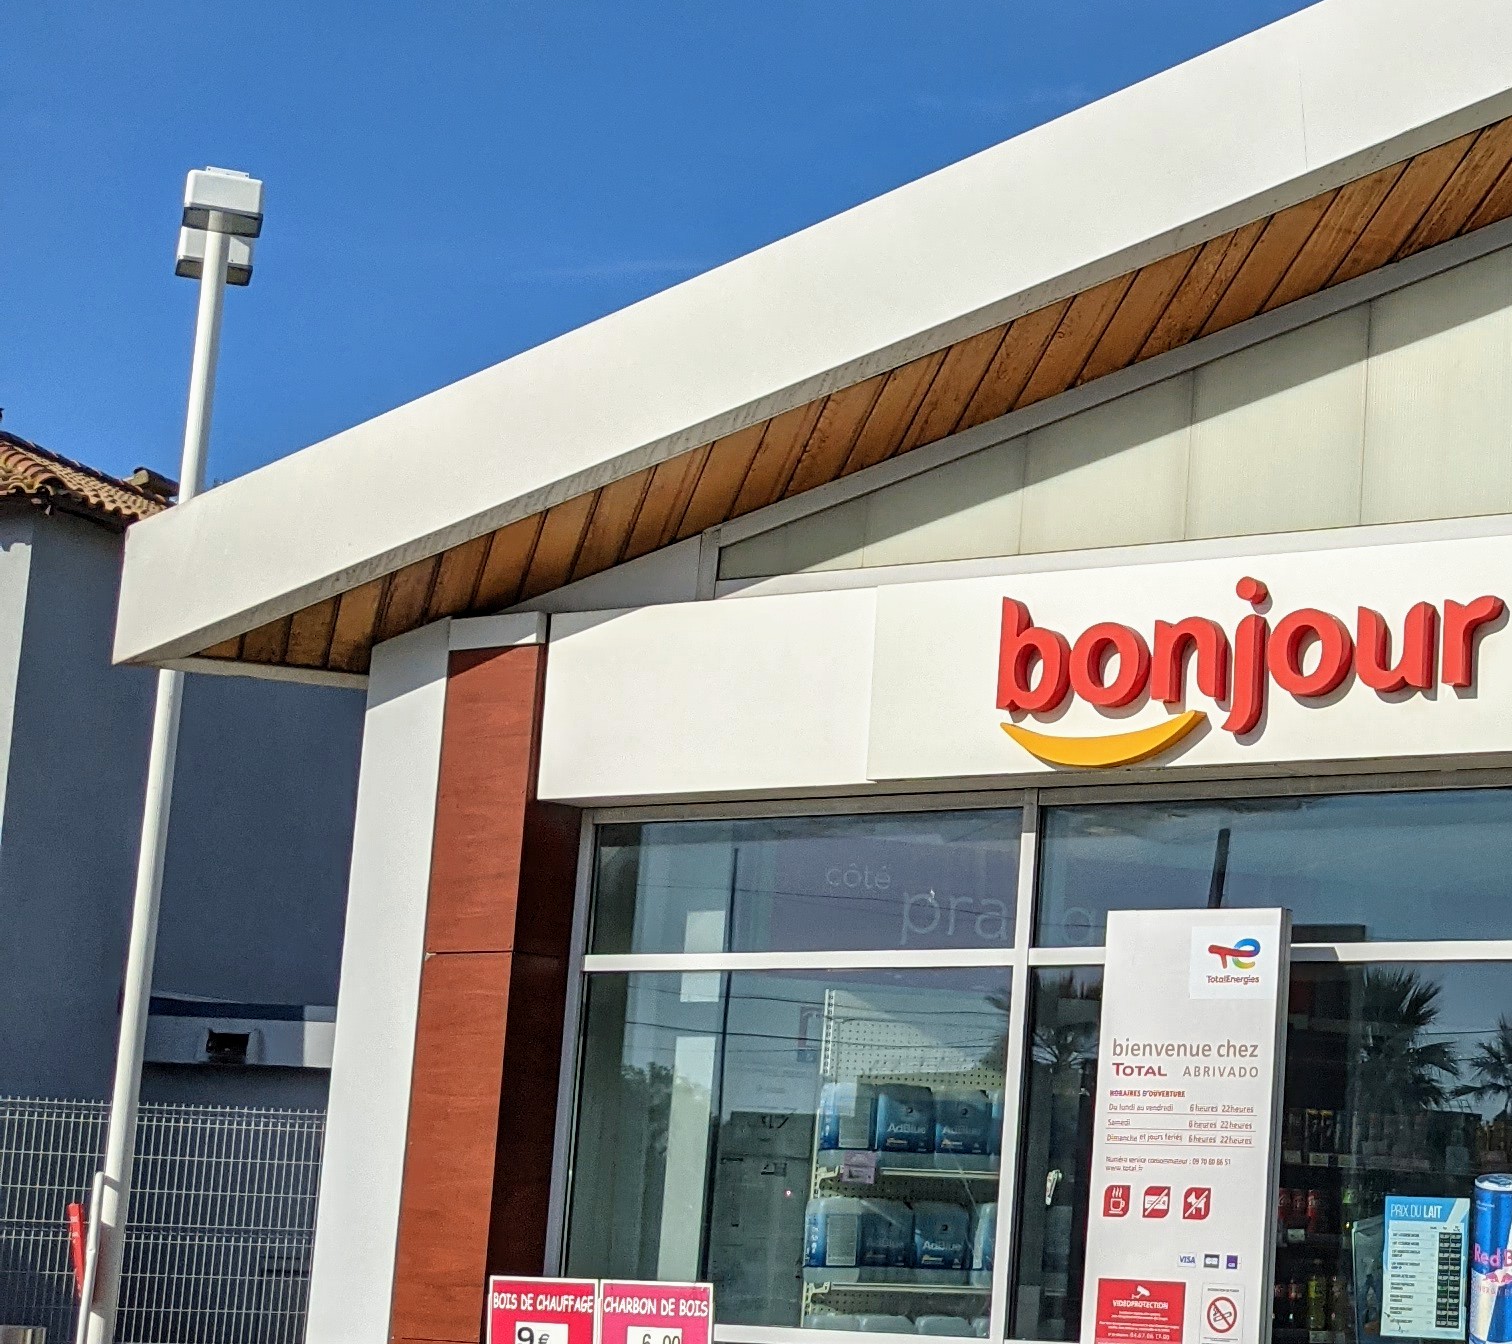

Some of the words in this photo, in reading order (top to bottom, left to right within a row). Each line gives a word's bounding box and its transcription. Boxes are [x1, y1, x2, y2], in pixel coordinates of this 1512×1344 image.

[996, 576, 1505, 735] bonjour
[824, 863, 891, 890] côté
[1206, 975, 1260, 985] TotalEnergies
[1112, 1038, 1212, 1058] bienvenue
[1217, 1039, 1259, 1058] chez
[1112, 1062, 1167, 1077] TOTAL
[1183, 1066, 1259, 1078] ABRIVADO
[1146, 1104, 1174, 1112] vendredi
[1107, 1134, 1138, 1142] Dimanche
[1147, 1133, 1164, 1143] jours
[1390, 1204, 1409, 1217] PRIX
[1410, 1204, 1422, 1218] DU
[1423, 1205, 1443, 1218] LAIT
[1179, 1256, 1196, 1264] VISA
[1474, 1242, 1501, 1267] Red
[493, 1293, 518, 1309] BOIS
[521, 1294, 534, 1310] DE
[536, 1294, 594, 1313] CHAUFFAGE
[604, 1296, 657, 1316] CHARBON
[661, 1298, 675, 1316] DE
[679, 1299, 709, 1318] BOIS
